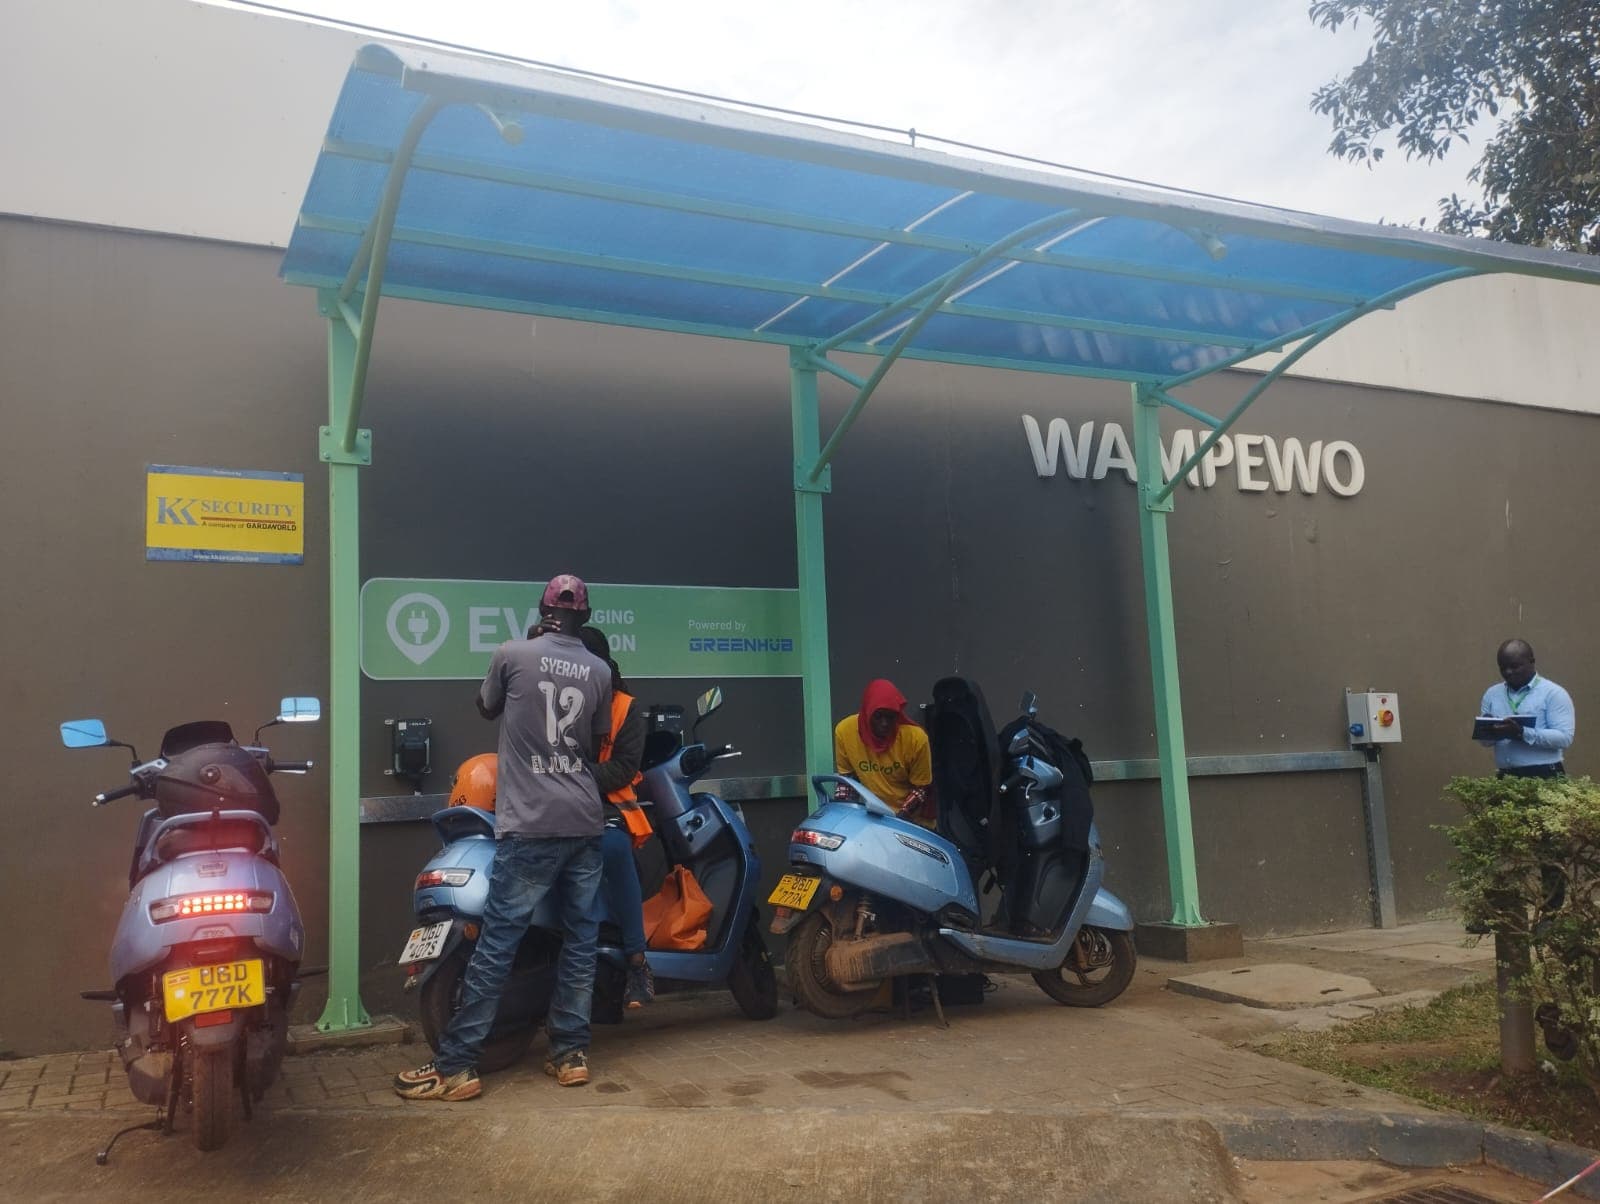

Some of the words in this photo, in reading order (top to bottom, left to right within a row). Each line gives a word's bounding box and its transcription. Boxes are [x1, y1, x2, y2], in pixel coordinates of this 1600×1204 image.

[1022, 414, 1365, 497] WAMPEWO
[156, 496, 199, 526] KK
[201, 500, 296, 517] SECURITY
[246, 522, 297, 532] GARDAWORLD
[469, 606, 541, 652] EV
[688, 619, 732, 631] Powered
[734, 620, 746, 632] by
[689, 637, 793, 652] GREENHUB
[539, 656, 591, 683] SYERAM
[537, 680, 585, 750] 12
[422, 923, 444, 942] UGD
[200, 963, 248, 987] UGD
[190, 983, 252, 1010] 777K
